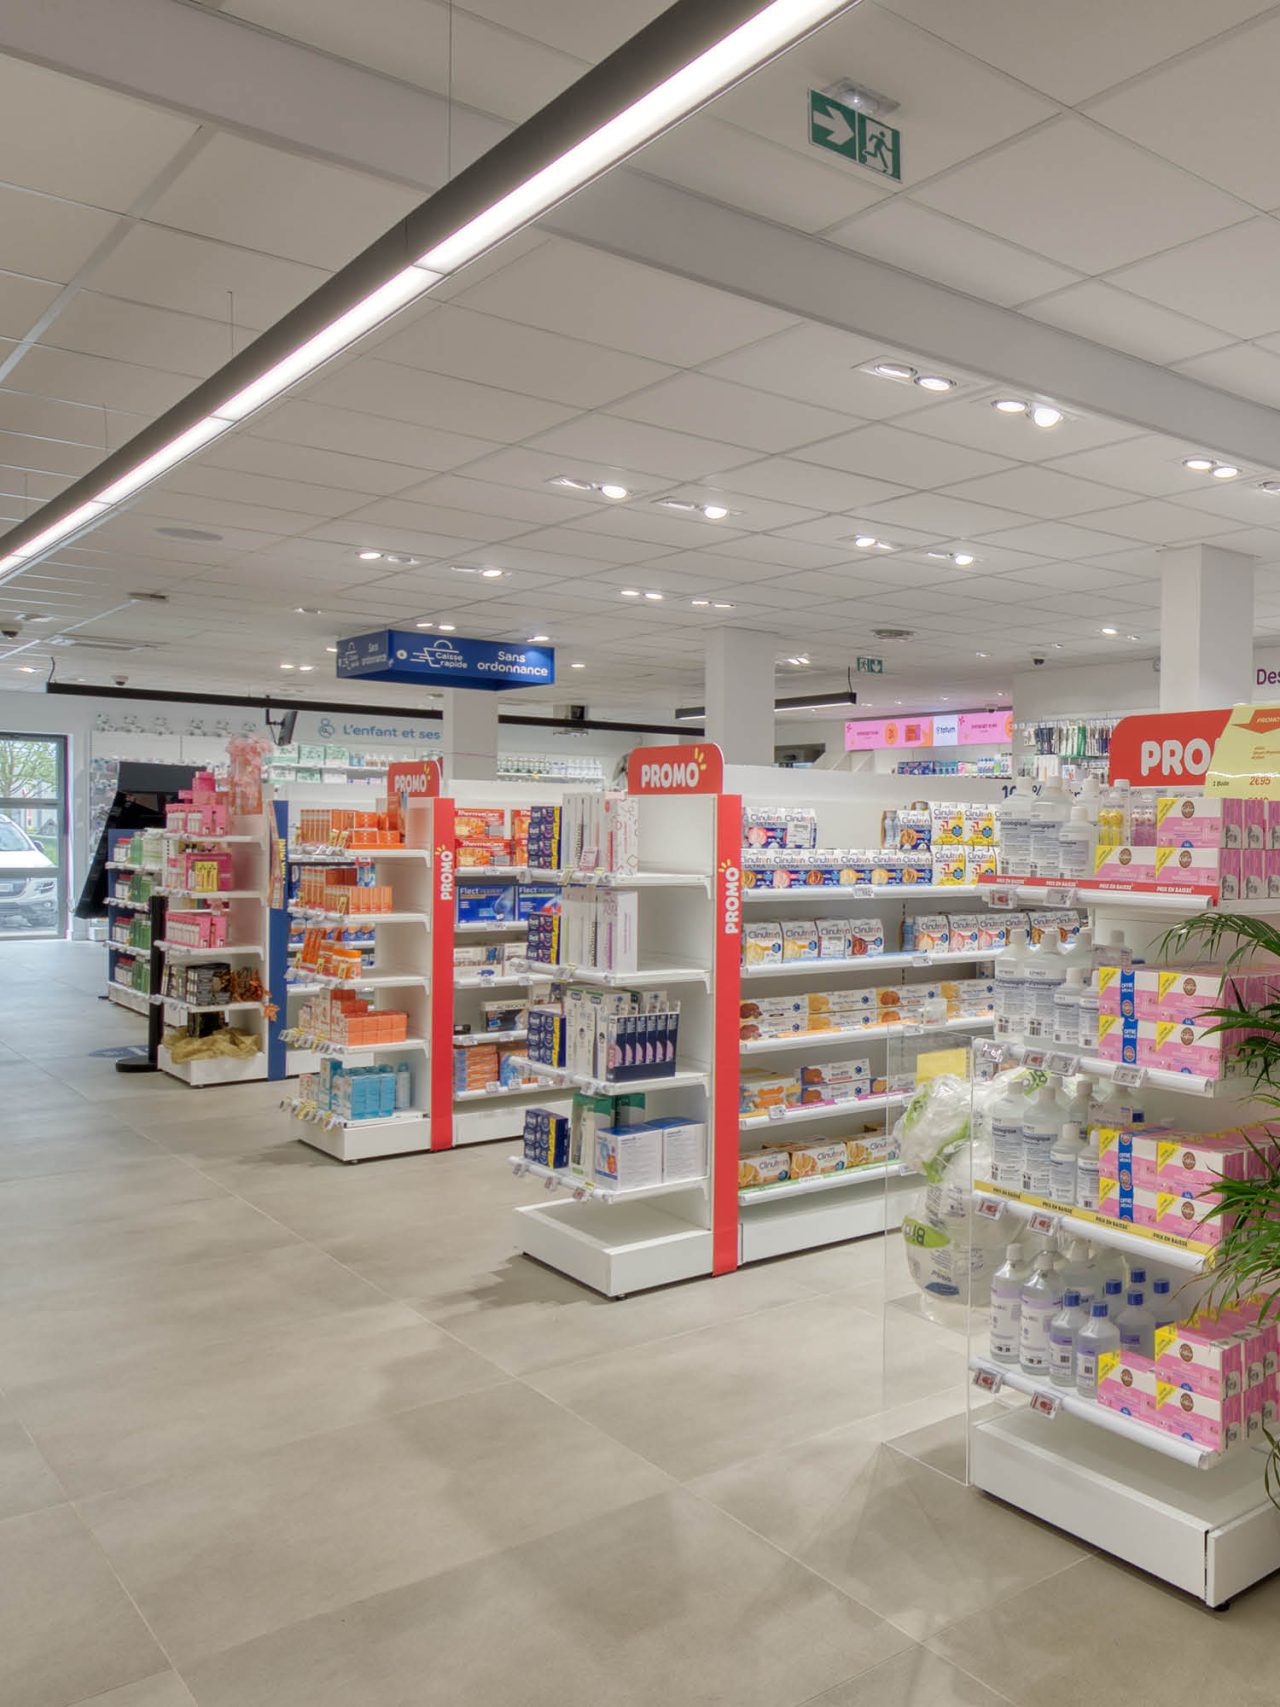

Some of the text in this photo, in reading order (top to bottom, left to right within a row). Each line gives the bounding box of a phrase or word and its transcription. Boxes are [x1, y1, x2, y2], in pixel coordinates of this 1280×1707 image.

[435, 651, 463, 661] Caisse
[498, 651, 526, 663] Sans
[439, 660, 468, 669] rapide
[477, 661, 548, 677] ordonnance
[343, 724, 441, 740] L'enfant et ses
[1141, 737, 1217, 777] PRO
[641, 761, 699, 788] PROMO
[1249, 775, 1271, 786] 2€95
[394, 773, 427, 793] PROMO
[441, 850, 453, 901] PROMO
[724, 866, 739, 935] PROMO
[1112, 1221, 1128, 1230] BAISSE
[1152, 1232, 1163, 1240] PRIX
[1171, 1237, 1188, 1247] BAISSE
